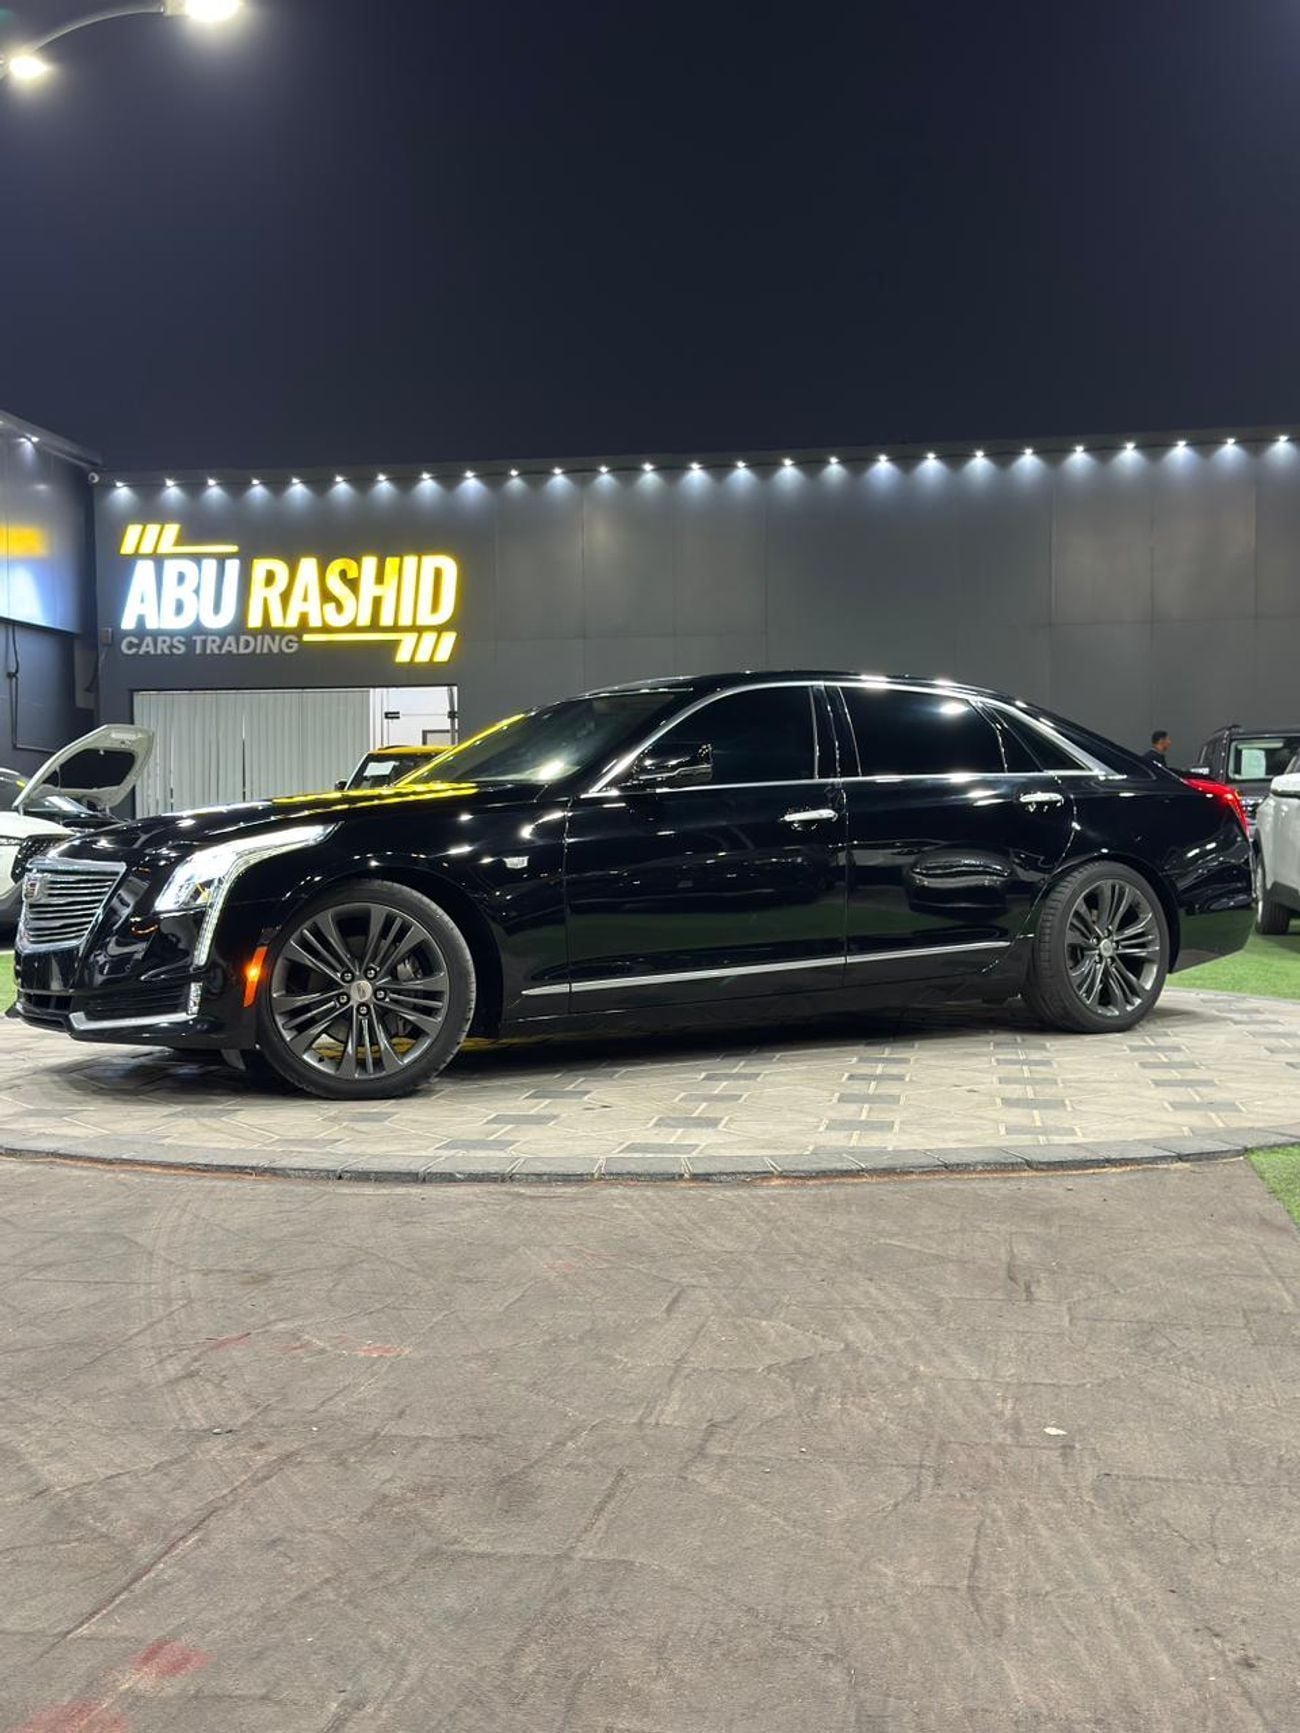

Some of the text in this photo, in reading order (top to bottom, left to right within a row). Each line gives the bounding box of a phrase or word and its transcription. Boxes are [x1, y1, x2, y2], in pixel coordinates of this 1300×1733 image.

[120, 555, 458, 629] ABU RASHID
[120, 634, 299, 655] CARS TRADING
